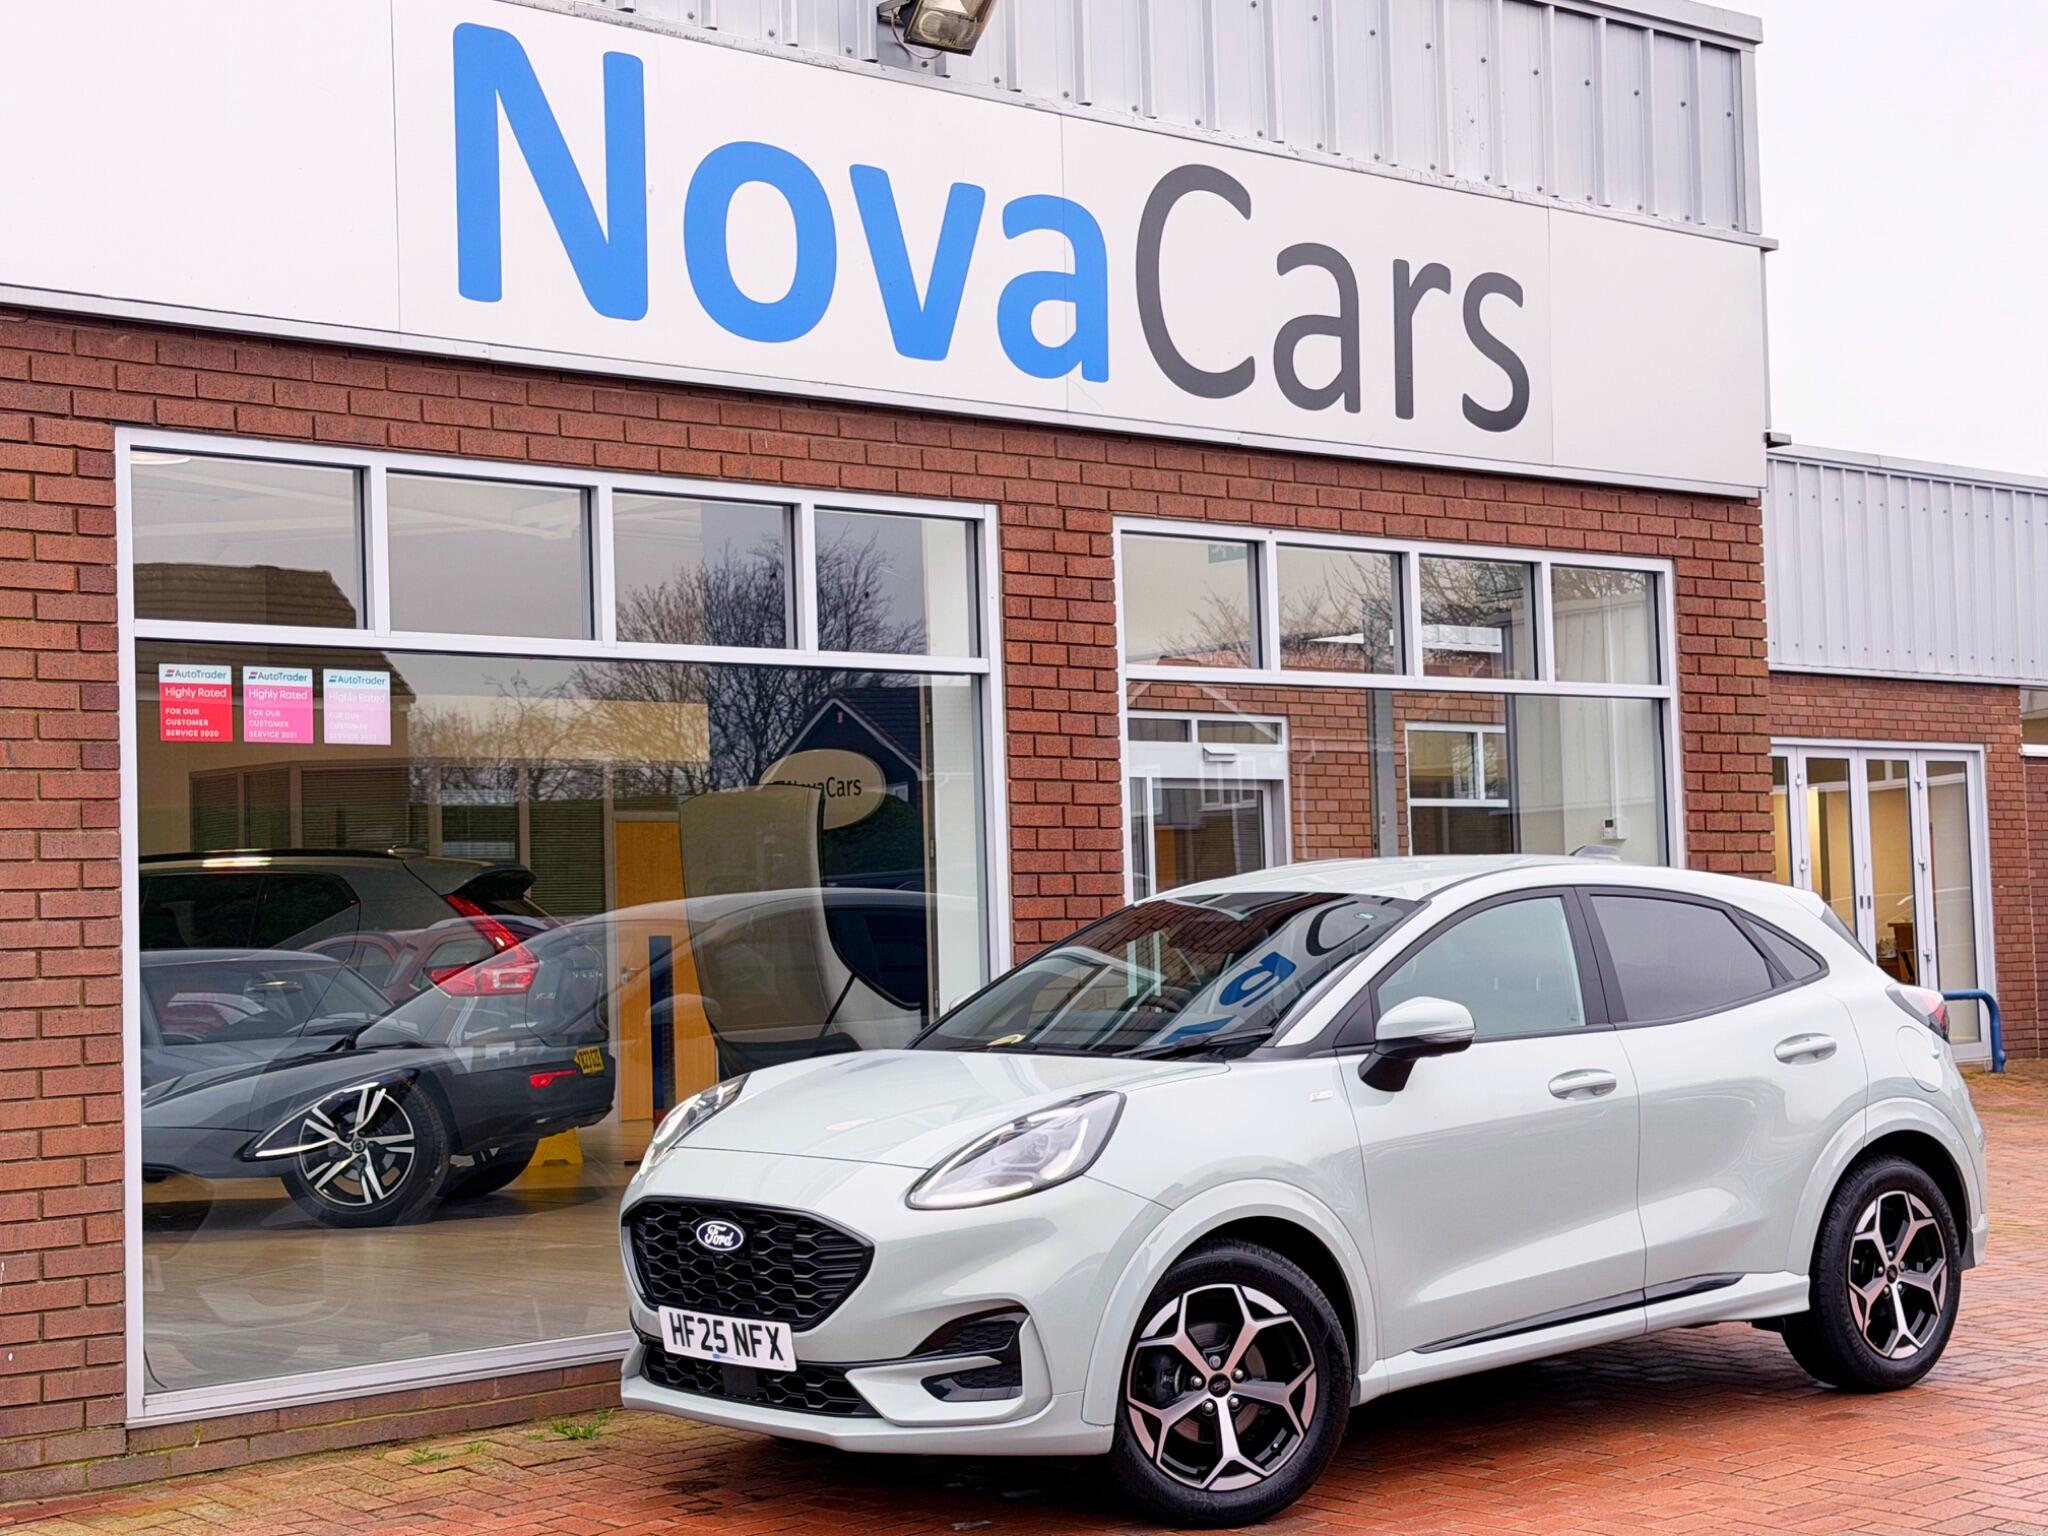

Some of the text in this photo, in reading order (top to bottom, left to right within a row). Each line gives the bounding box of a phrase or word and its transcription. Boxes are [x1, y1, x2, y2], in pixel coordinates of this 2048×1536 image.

[453, 22, 1530, 433] NovaCars
[175, 669, 227, 679] AutoTrader
[258, 671, 308, 682] AutoTrader
[337, 675, 385, 685] AutoTrader
[165, 686, 227, 699] Highly Rated
[248, 688, 308, 700] Highly Rated
[165, 707, 181, 715] FOR
[165, 718, 209, 727] CUSTOMER
[165, 729, 199, 737] SERVICE
[704, 1224, 735, 1247] Ford
[669, 1311, 785, 1362] HF25 NFX
